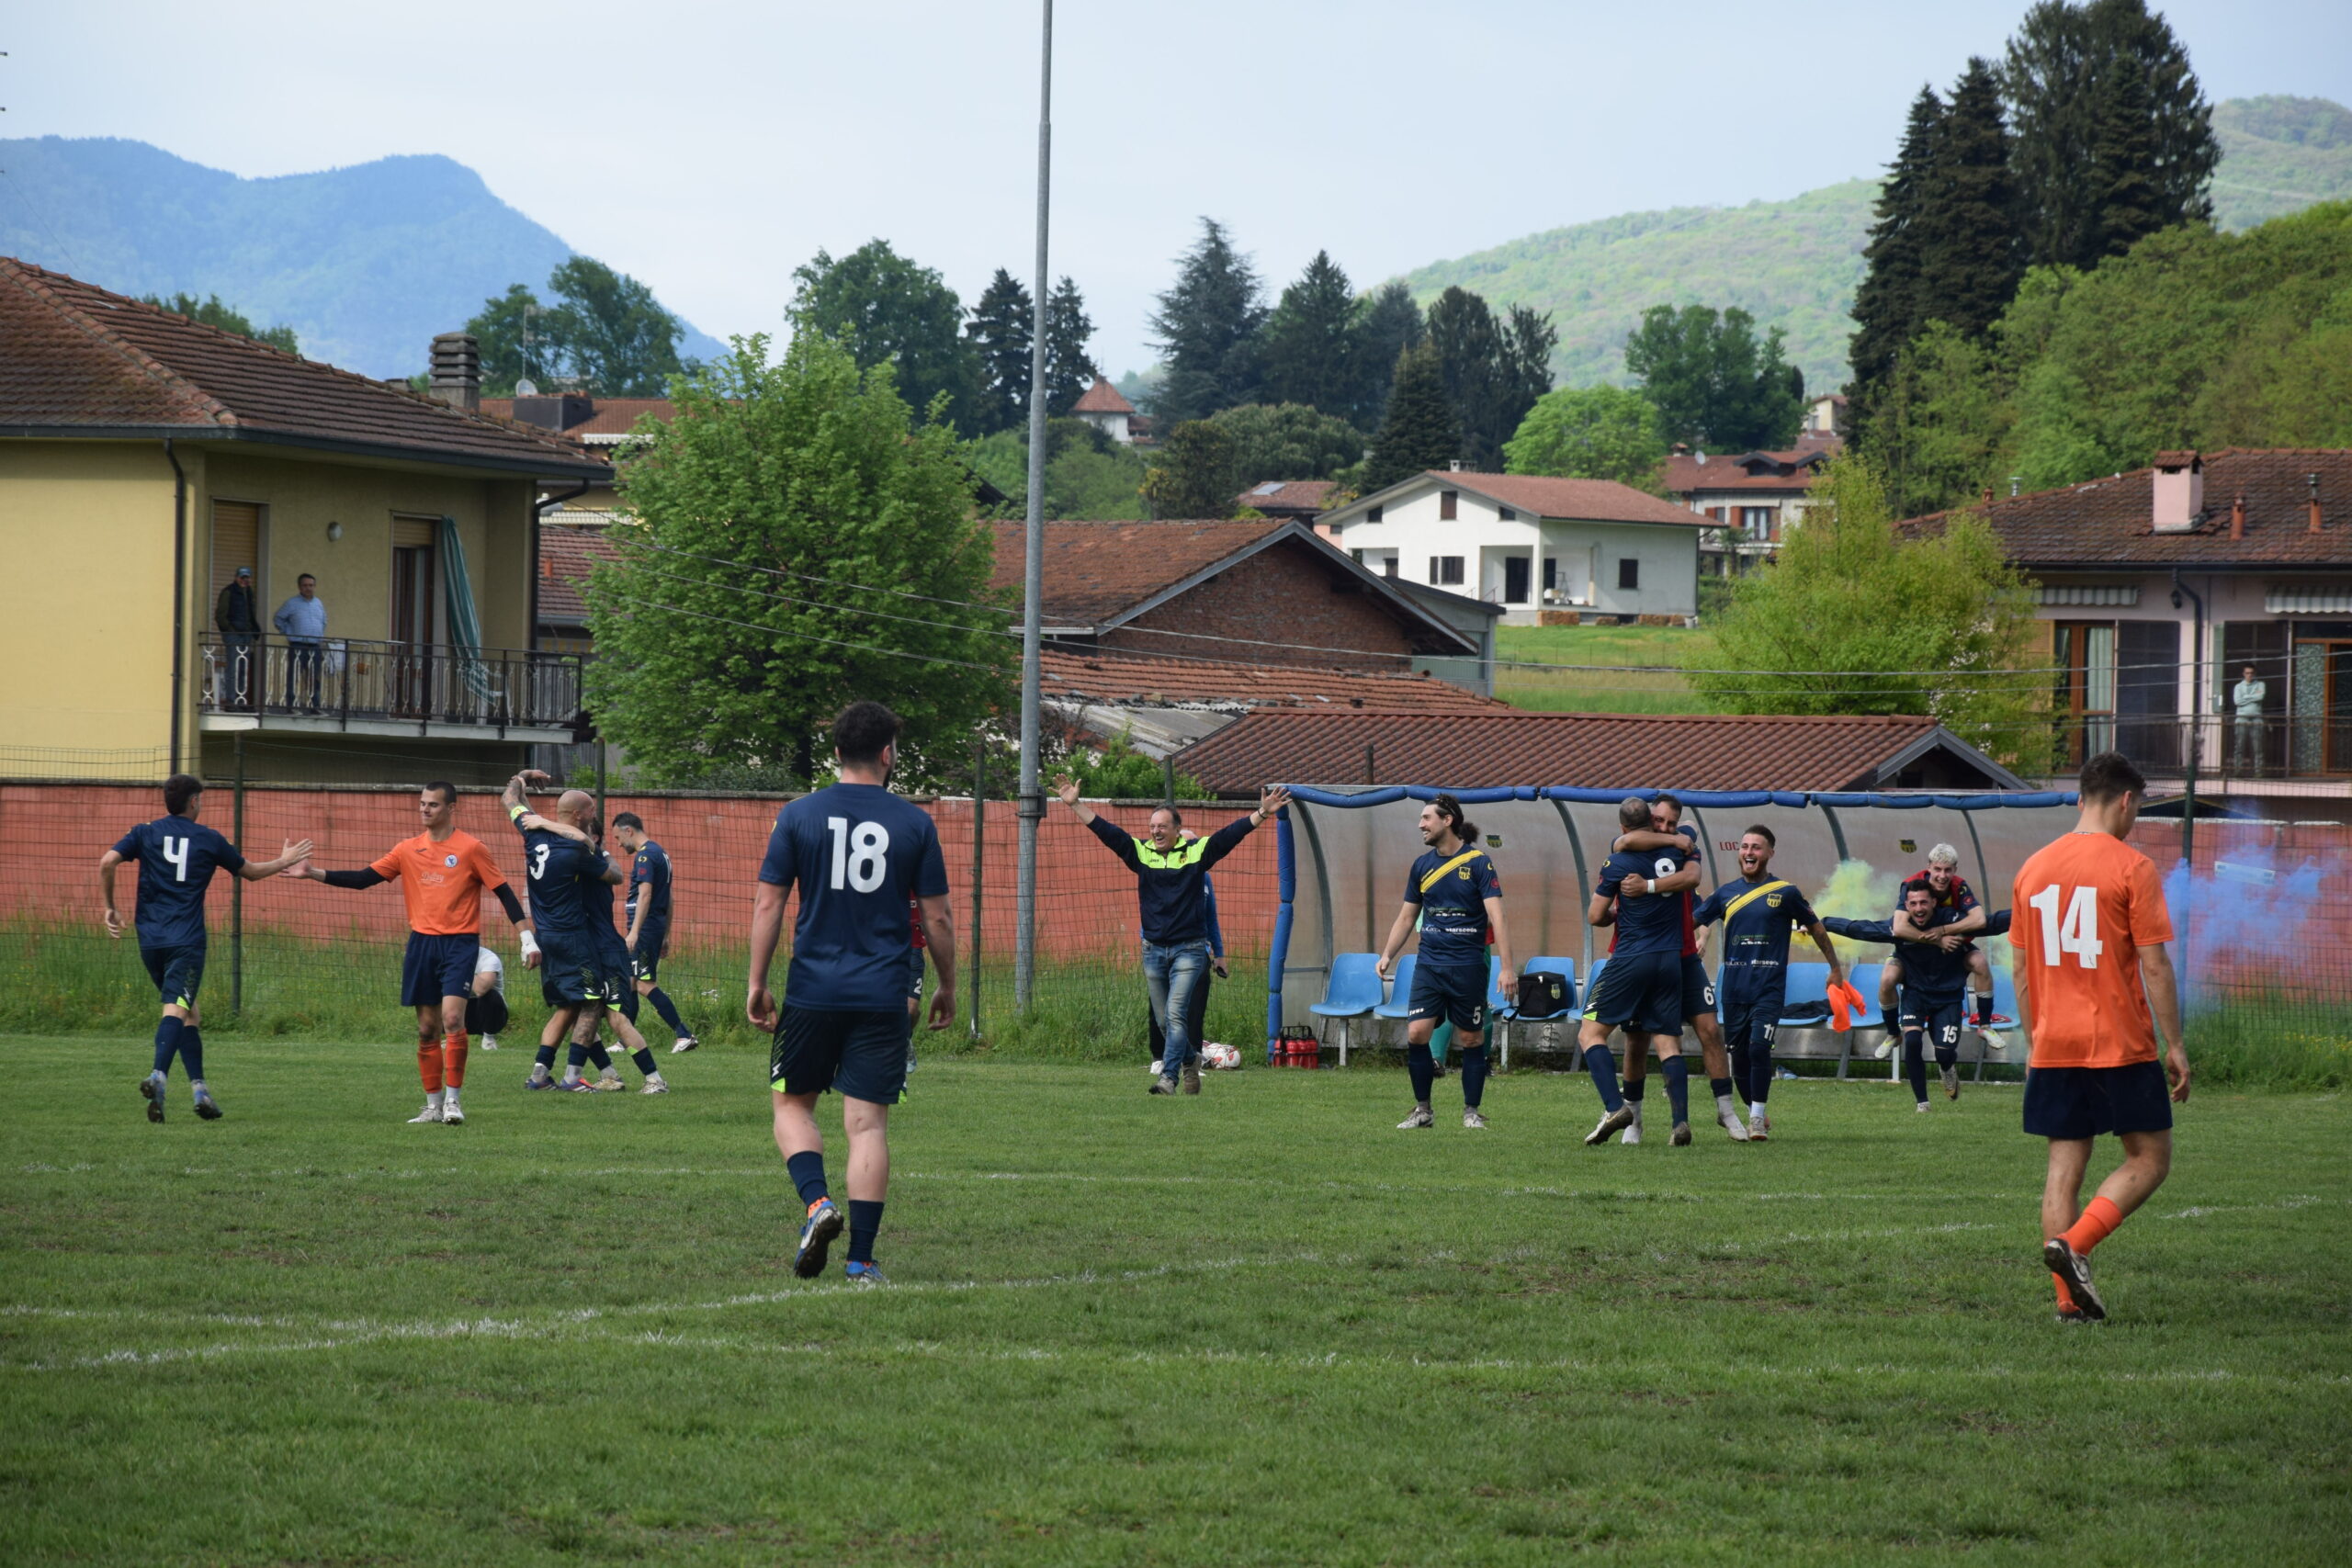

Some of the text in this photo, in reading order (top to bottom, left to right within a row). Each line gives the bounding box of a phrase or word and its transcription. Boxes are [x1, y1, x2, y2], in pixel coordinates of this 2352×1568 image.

[164, 836, 189, 882] 4
[529, 843, 550, 881] 3
[828, 817, 889, 893] 18
[2030, 884, 2103, 969] 14
[913, 977, 923, 995] 2
[1703, 986, 1714, 1006] 6
[1472, 1006, 1481, 1025] 5
[1942, 1024, 1959, 1043] 15
